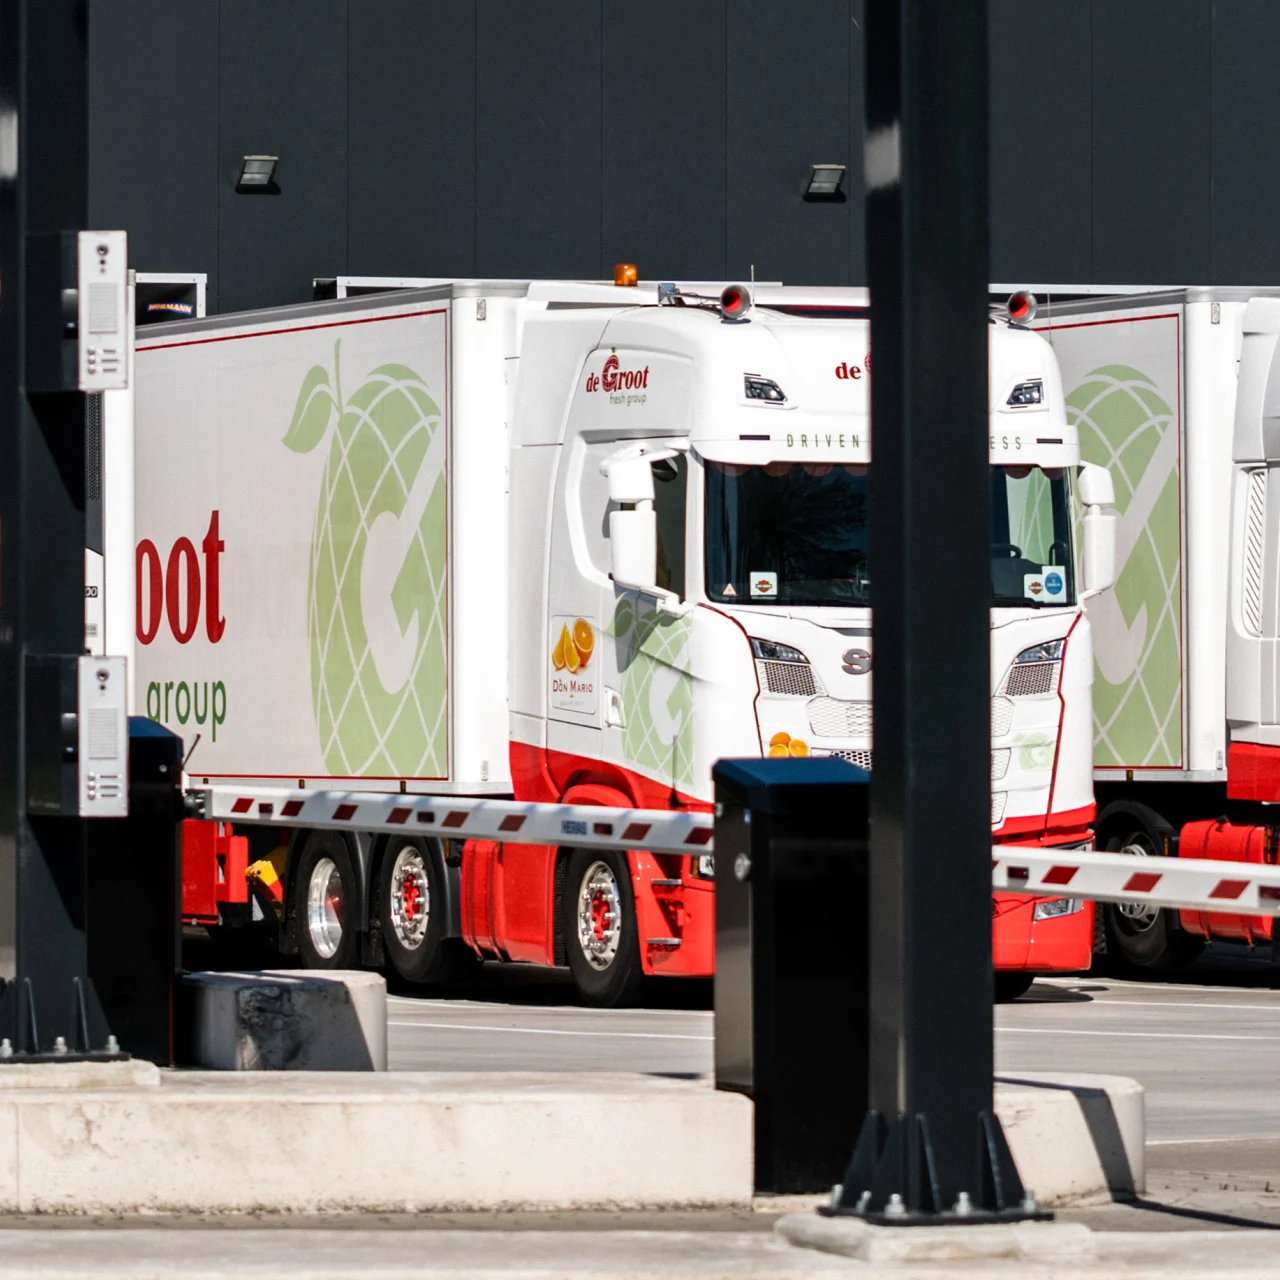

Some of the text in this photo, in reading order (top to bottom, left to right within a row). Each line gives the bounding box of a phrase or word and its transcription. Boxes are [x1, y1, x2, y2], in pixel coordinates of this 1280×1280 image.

[586, 355, 649, 392] de Groot
[835, 362, 861, 380] de
[787, 434, 860, 448] DRIVEN
